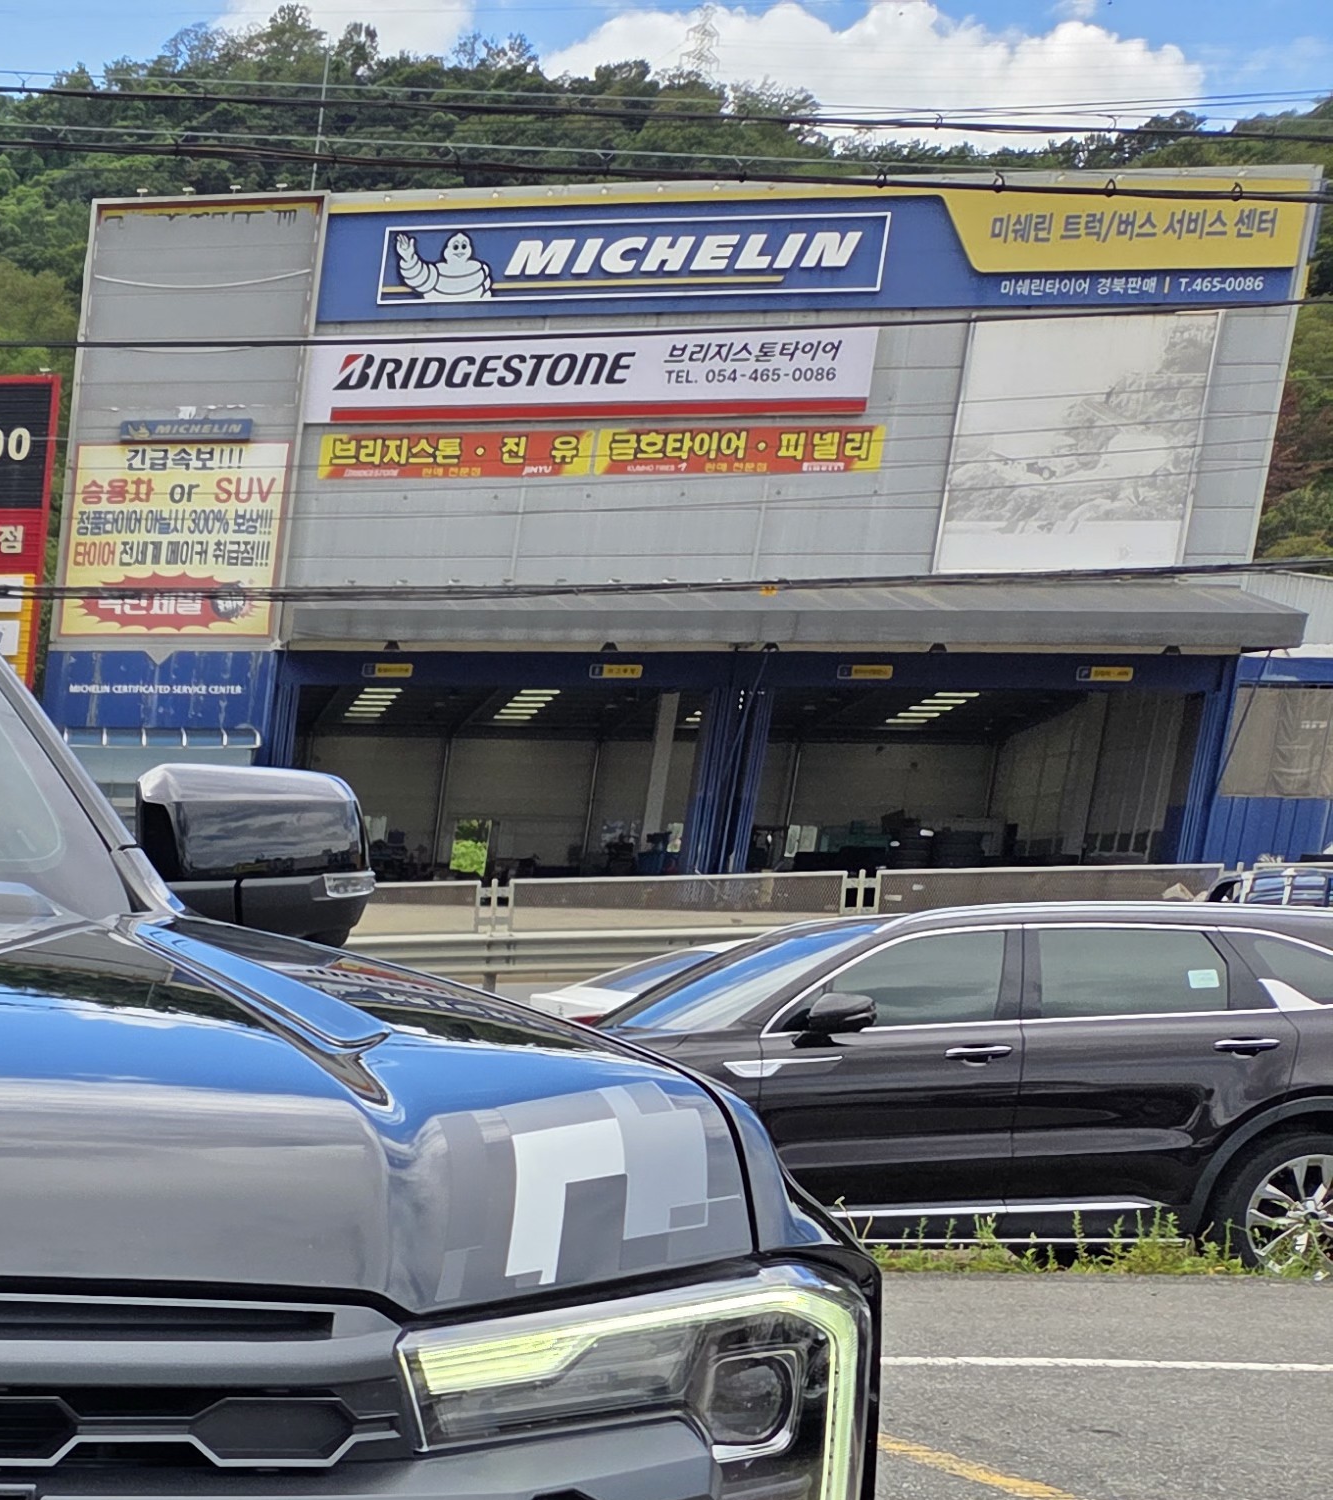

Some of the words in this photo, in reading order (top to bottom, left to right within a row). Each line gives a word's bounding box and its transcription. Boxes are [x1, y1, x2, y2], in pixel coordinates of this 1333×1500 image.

[991, 212, 1053, 243] 미쉐린
[1060, 210, 1157, 243] 트럭/버스
[1162, 208, 1228, 241] 서비스
[1233, 207, 1278, 239] 센터
[503, 230, 863, 277] MICHELIN
[1000, 276, 1090, 296] 미쉐린타이어
[1096, 275, 1156, 295] 경북판매
[1178, 275, 1265, 294] T.465-0086
[663, 340, 843, 365] 브리지스톤타이어
[332, 351, 637, 391] BRIDGESTONE
[665, 367, 699, 385] TEL.
[705, 365, 837, 384] 054-465-0086
[154, 423, 243, 435] MICHELIN
[331, 436, 462, 465] 브리지스톤
[609, 430, 749, 461] 금호타이어
[126, 447, 245, 472] 긴급속보!!!
[81, 477, 155, 505] 승용차
[169, 483, 200, 504] or
[214, 476, 276, 504] SUV
[188, 508, 229, 535] 300%
[73, 540, 117, 567] 타이어
[119, 540, 163, 567] 전세계
[165, 540, 209, 567] 메이커
[69, 684, 110, 694] MICHELIN
[172, 684, 207, 694] SERVICE
[208, 684, 242, 694] CENTER
